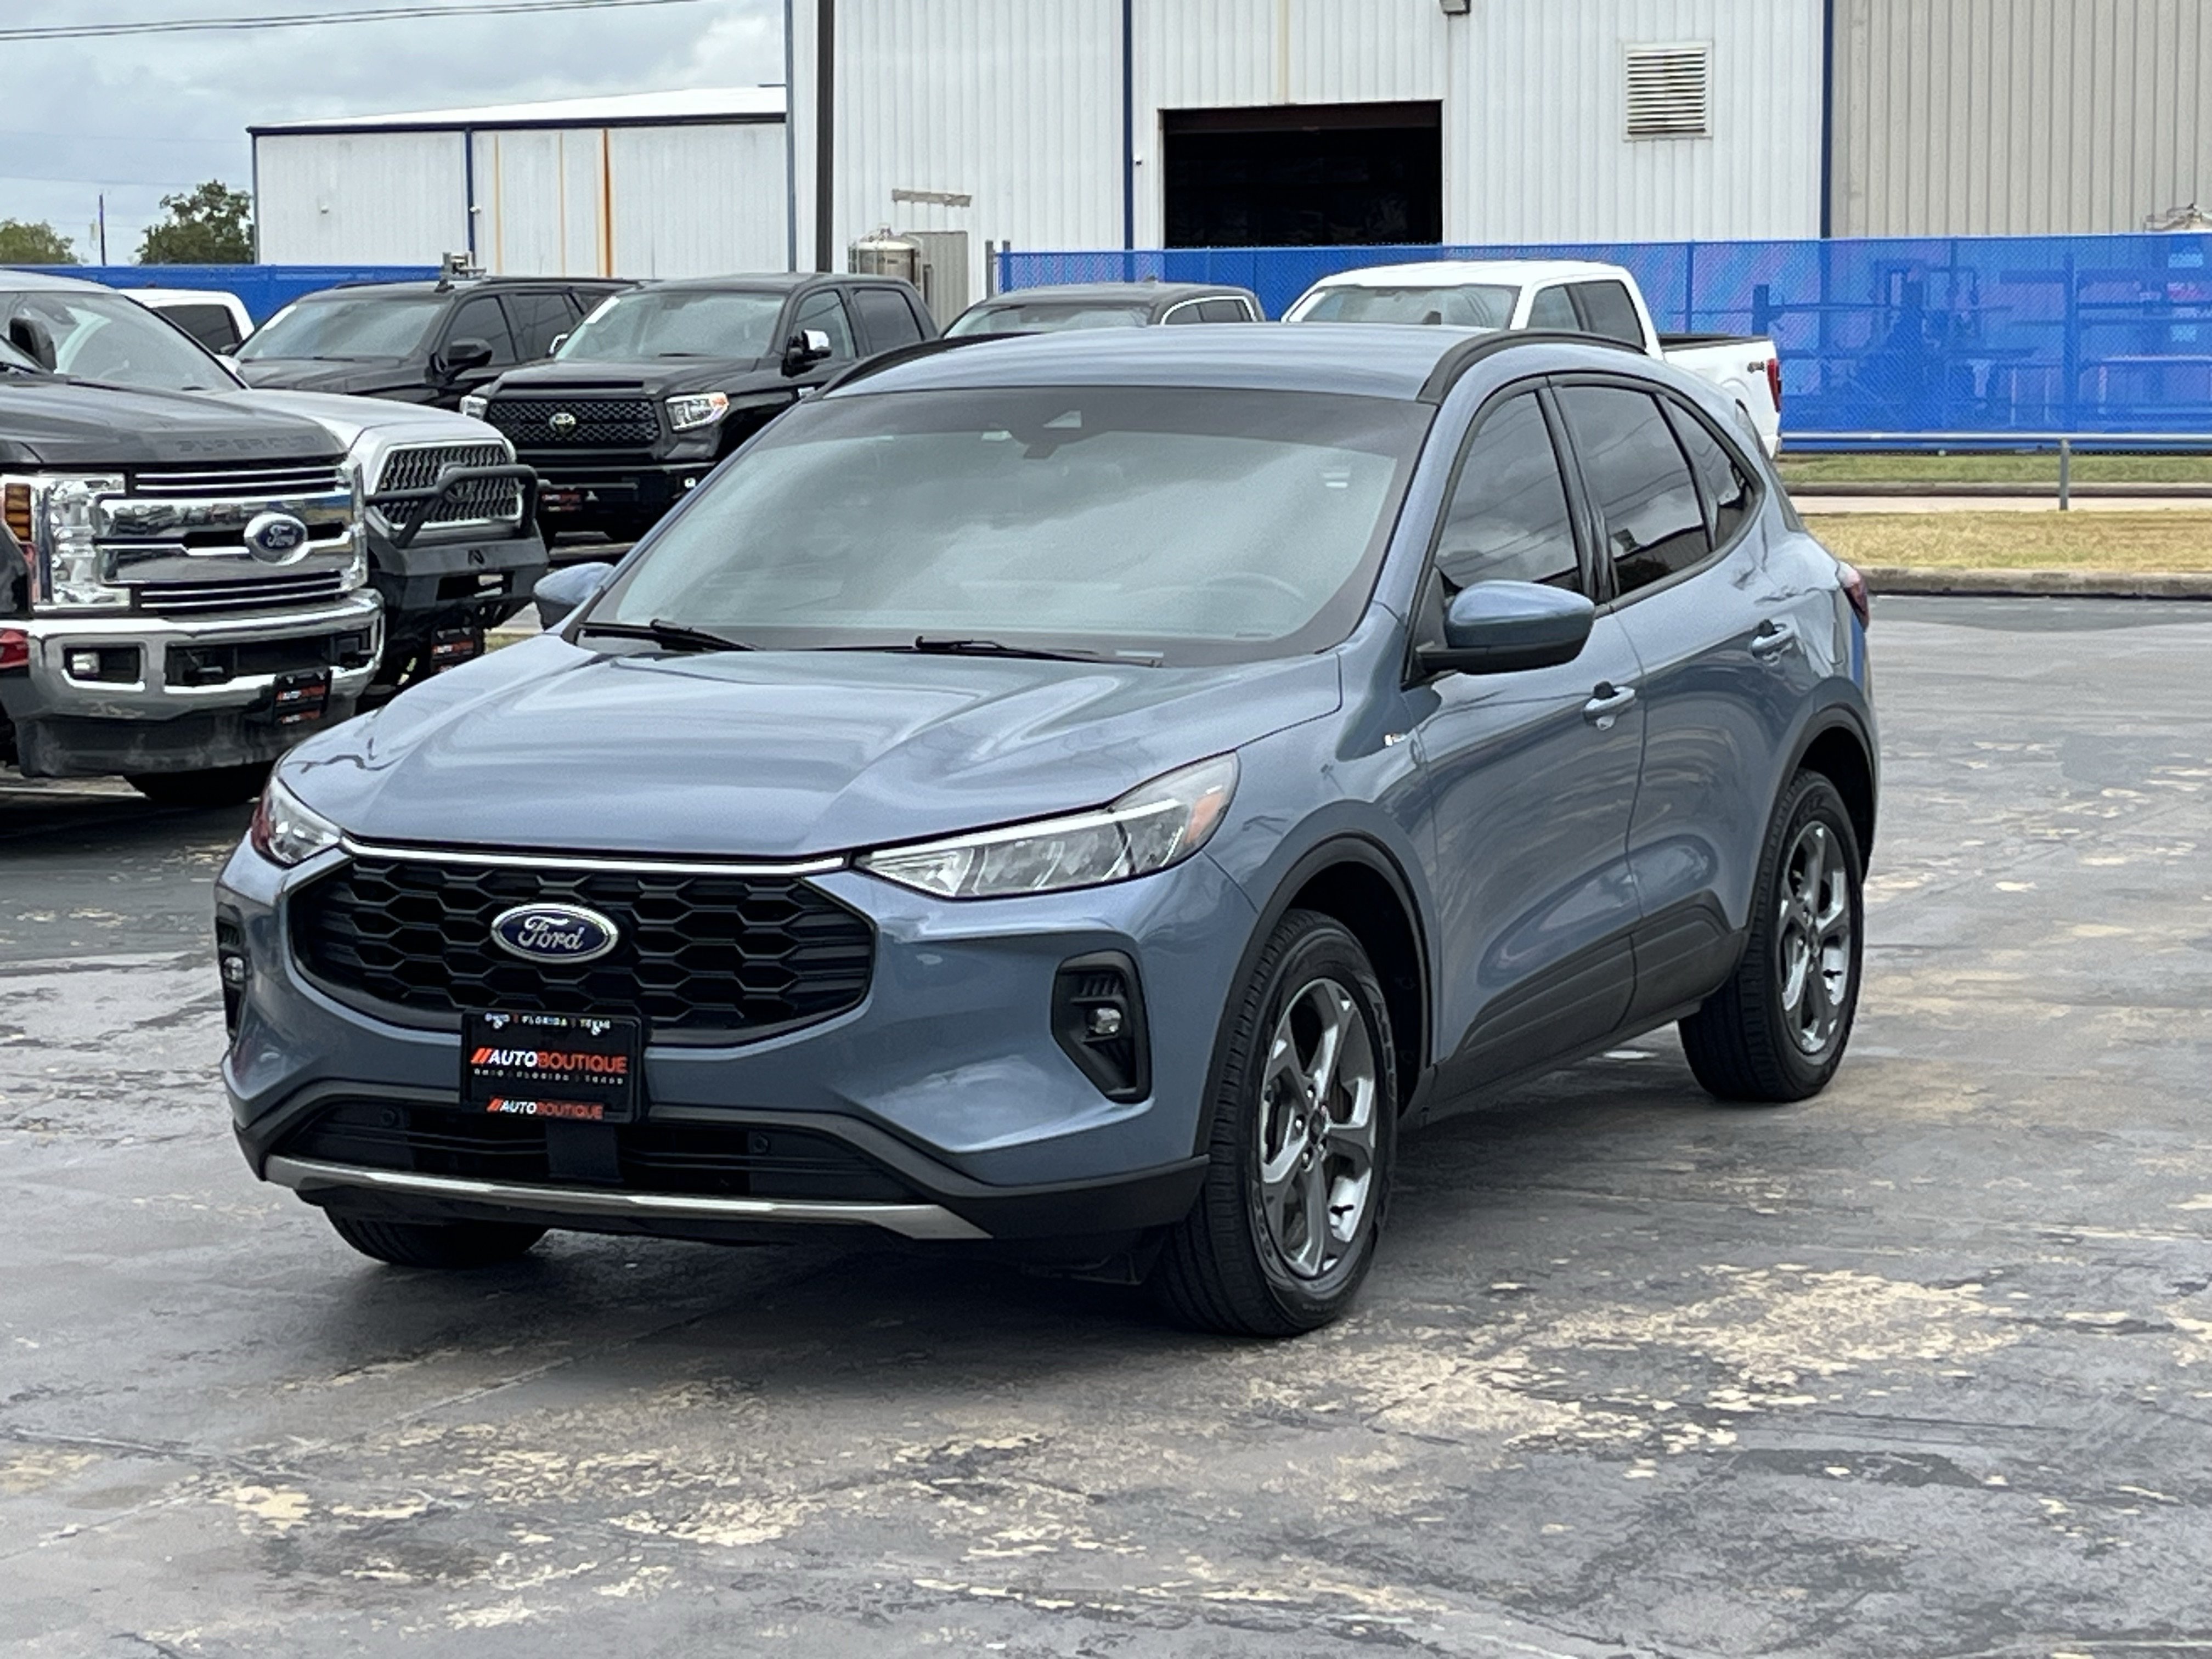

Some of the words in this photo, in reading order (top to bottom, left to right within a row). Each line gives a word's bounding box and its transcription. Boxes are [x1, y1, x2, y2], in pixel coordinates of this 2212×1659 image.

[518, 915, 585, 950] Ford
[488, 1049, 628, 1074] AUTOBOUTIQUE
[499, 1100, 603, 1119] AUTOBOUTIQUE
